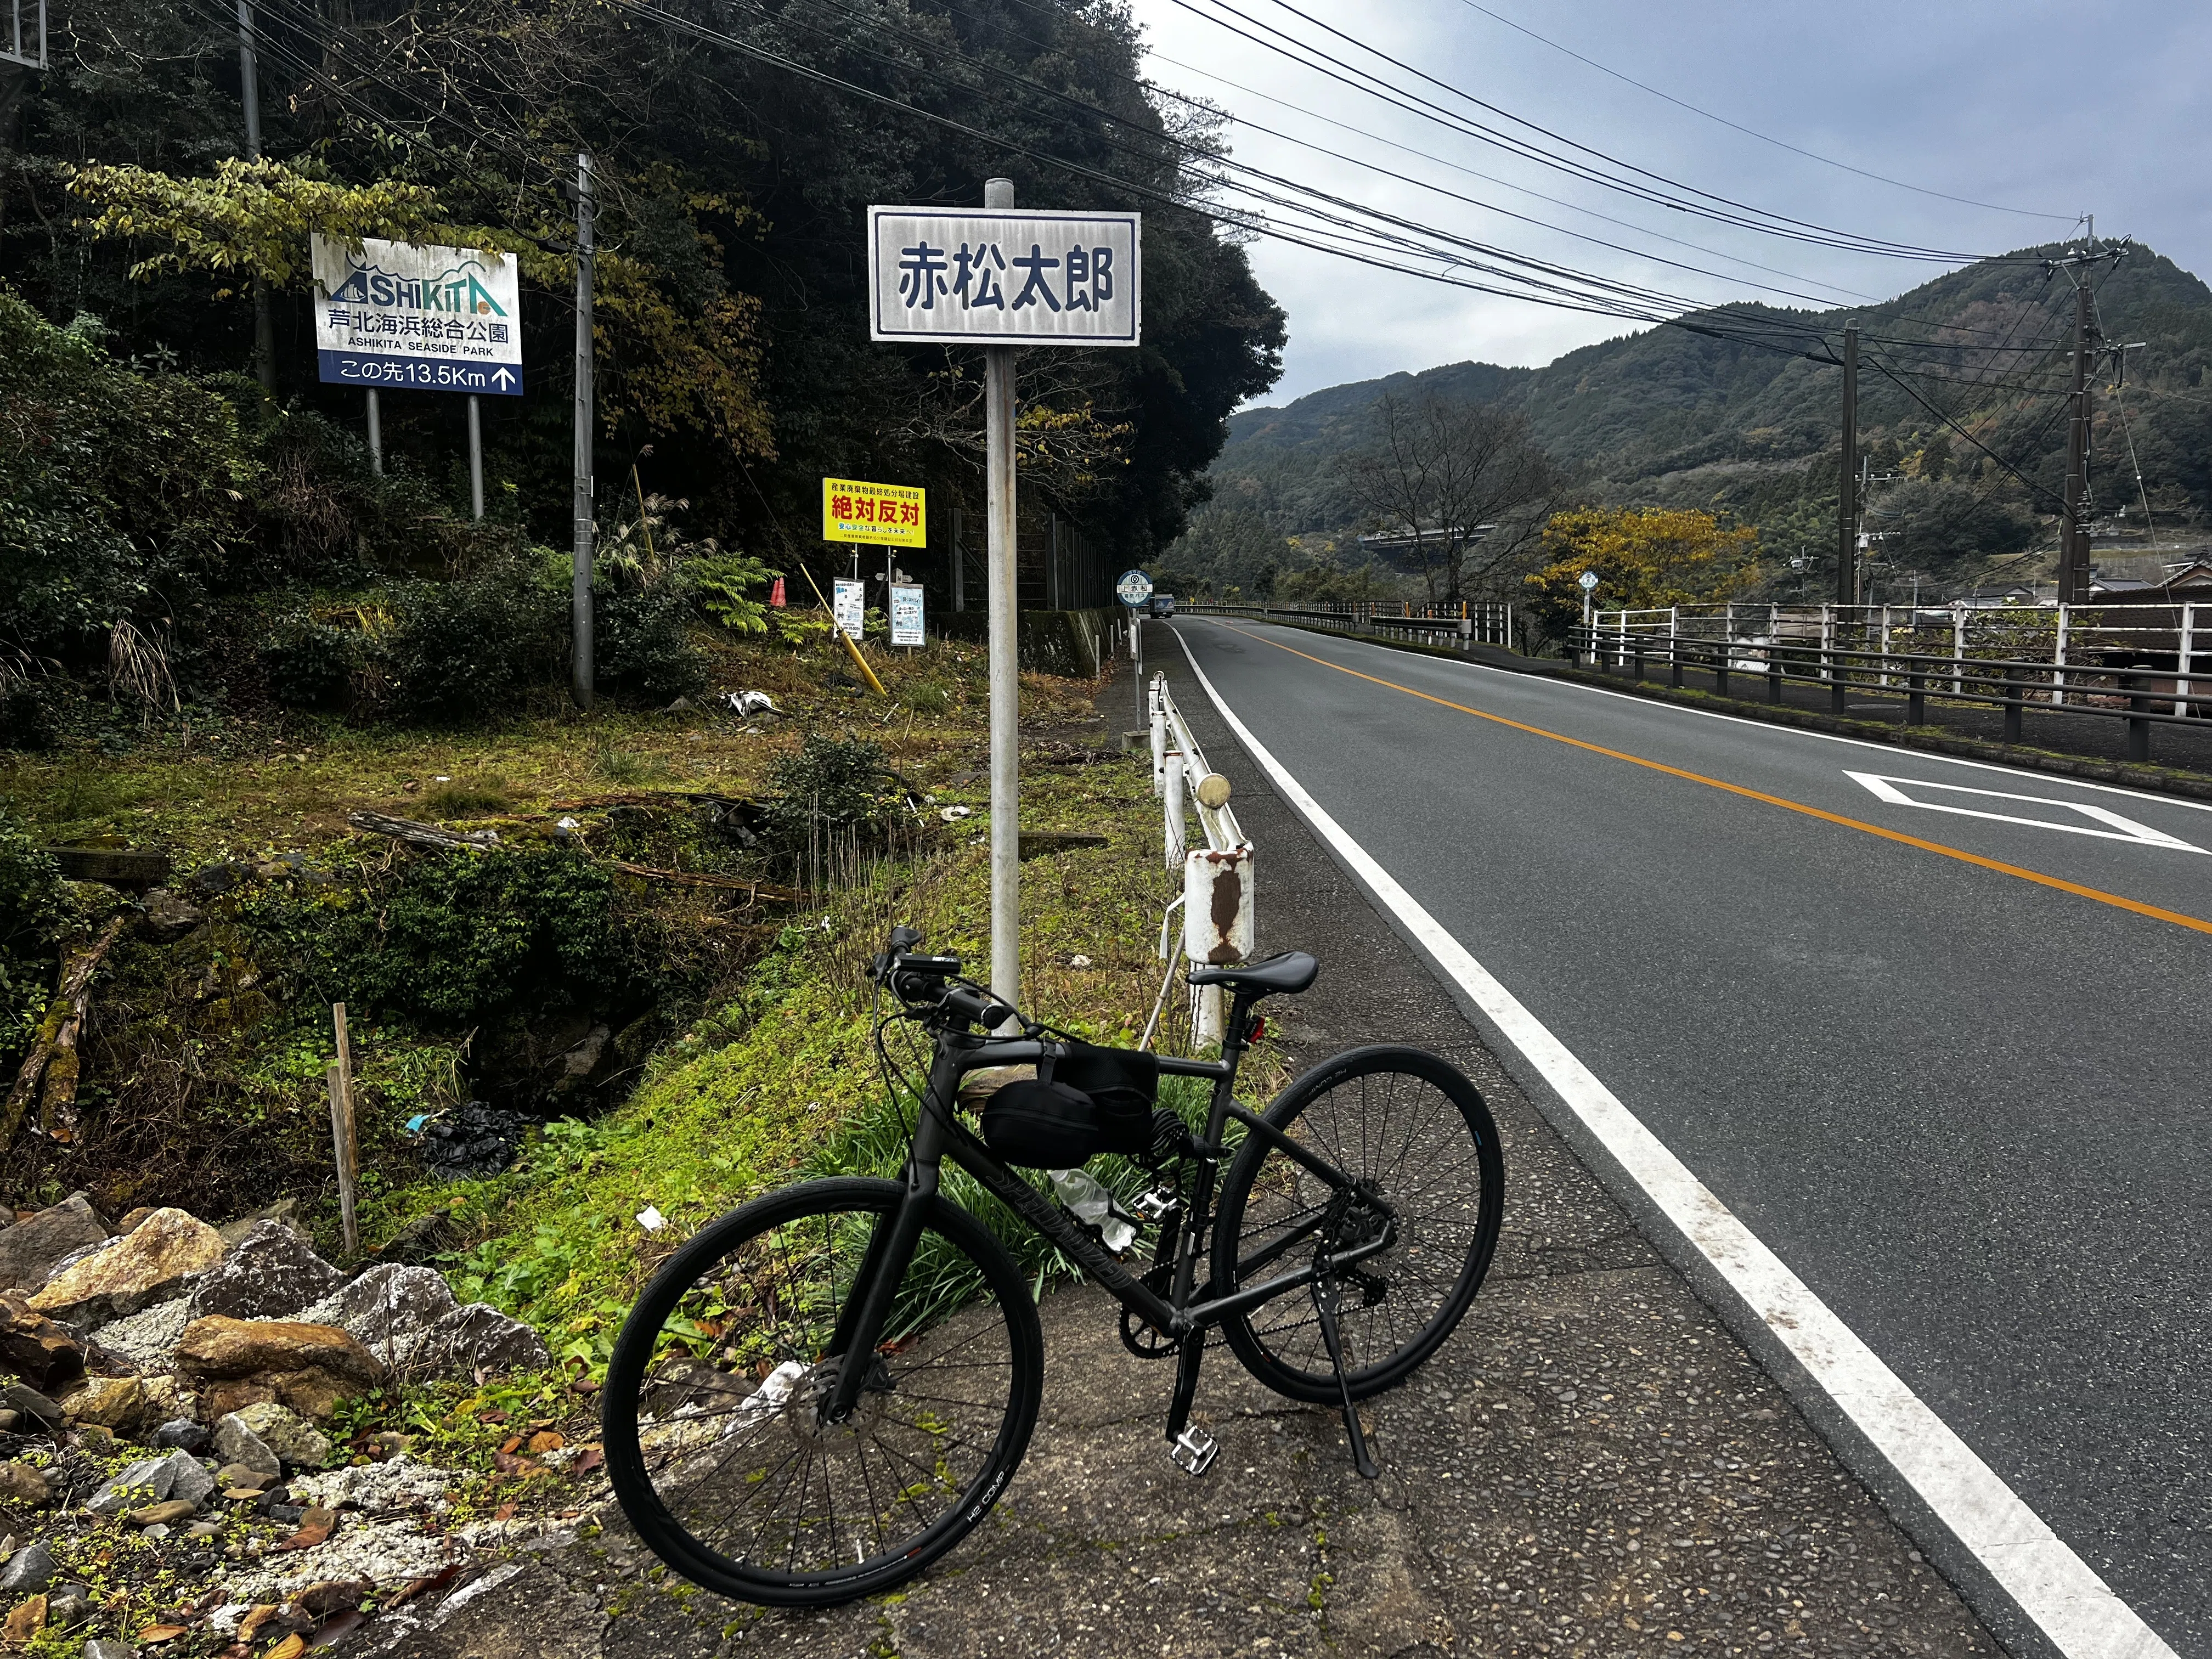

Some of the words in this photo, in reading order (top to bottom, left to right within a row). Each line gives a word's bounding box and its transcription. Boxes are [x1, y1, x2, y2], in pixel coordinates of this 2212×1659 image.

[899, 241, 1113, 312] 赤松太郎
[328, 308, 508, 343] 芦北海浜総合公園
[348, 337, 402, 349] ASHIKITA
[408, 342, 456, 353] SEASIDE
[463, 346, 493, 356] PARK
[341, 360, 486, 387] この先13.5Km
[832, 483, 919, 500] 産業廃棄物最終処分場建設
[832, 494, 919, 526] 絶対反対
[967, 1505, 982, 1522] H2
[982, 1471, 1005, 1505] COMP
